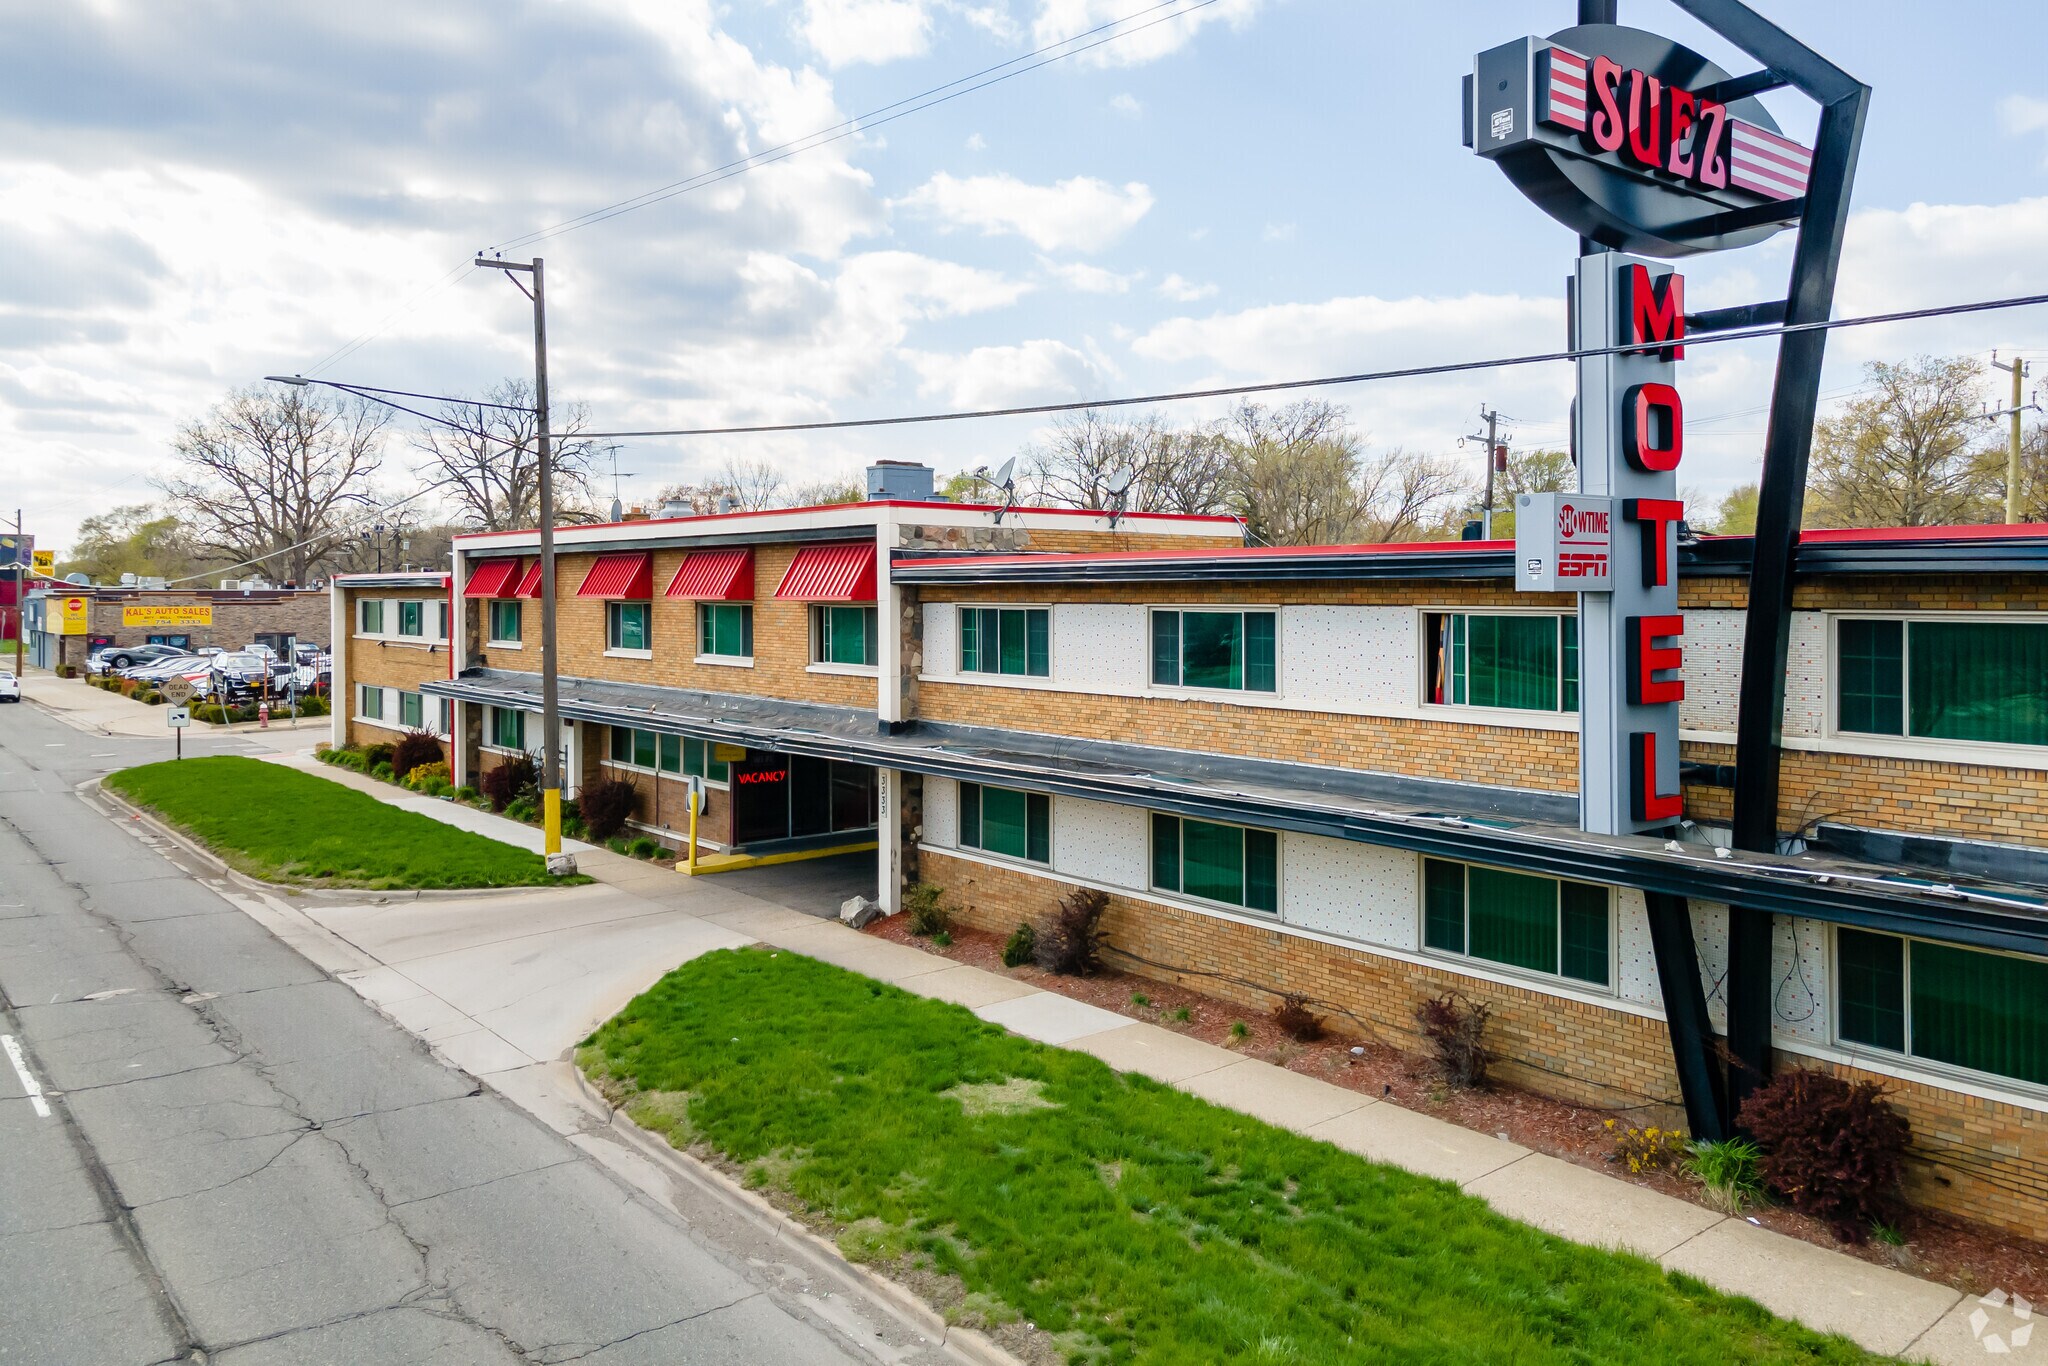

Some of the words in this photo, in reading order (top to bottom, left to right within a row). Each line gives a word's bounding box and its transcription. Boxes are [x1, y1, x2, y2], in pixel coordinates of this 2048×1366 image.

[1592, 54, 1726, 190] SUEZ
[1558, 504, 1608, 538] SHOWTIME
[1632, 263, 1684, 822] MOTEL
[1558, 553, 1608, 577] ESPN
[126, 608, 152, 617] KAL'S
[155, 607, 180, 615] AUTO
[182, 607, 210, 616] SALES
[168, 683, 189, 691] DEAD
[737, 770, 786, 784] VACANCY
